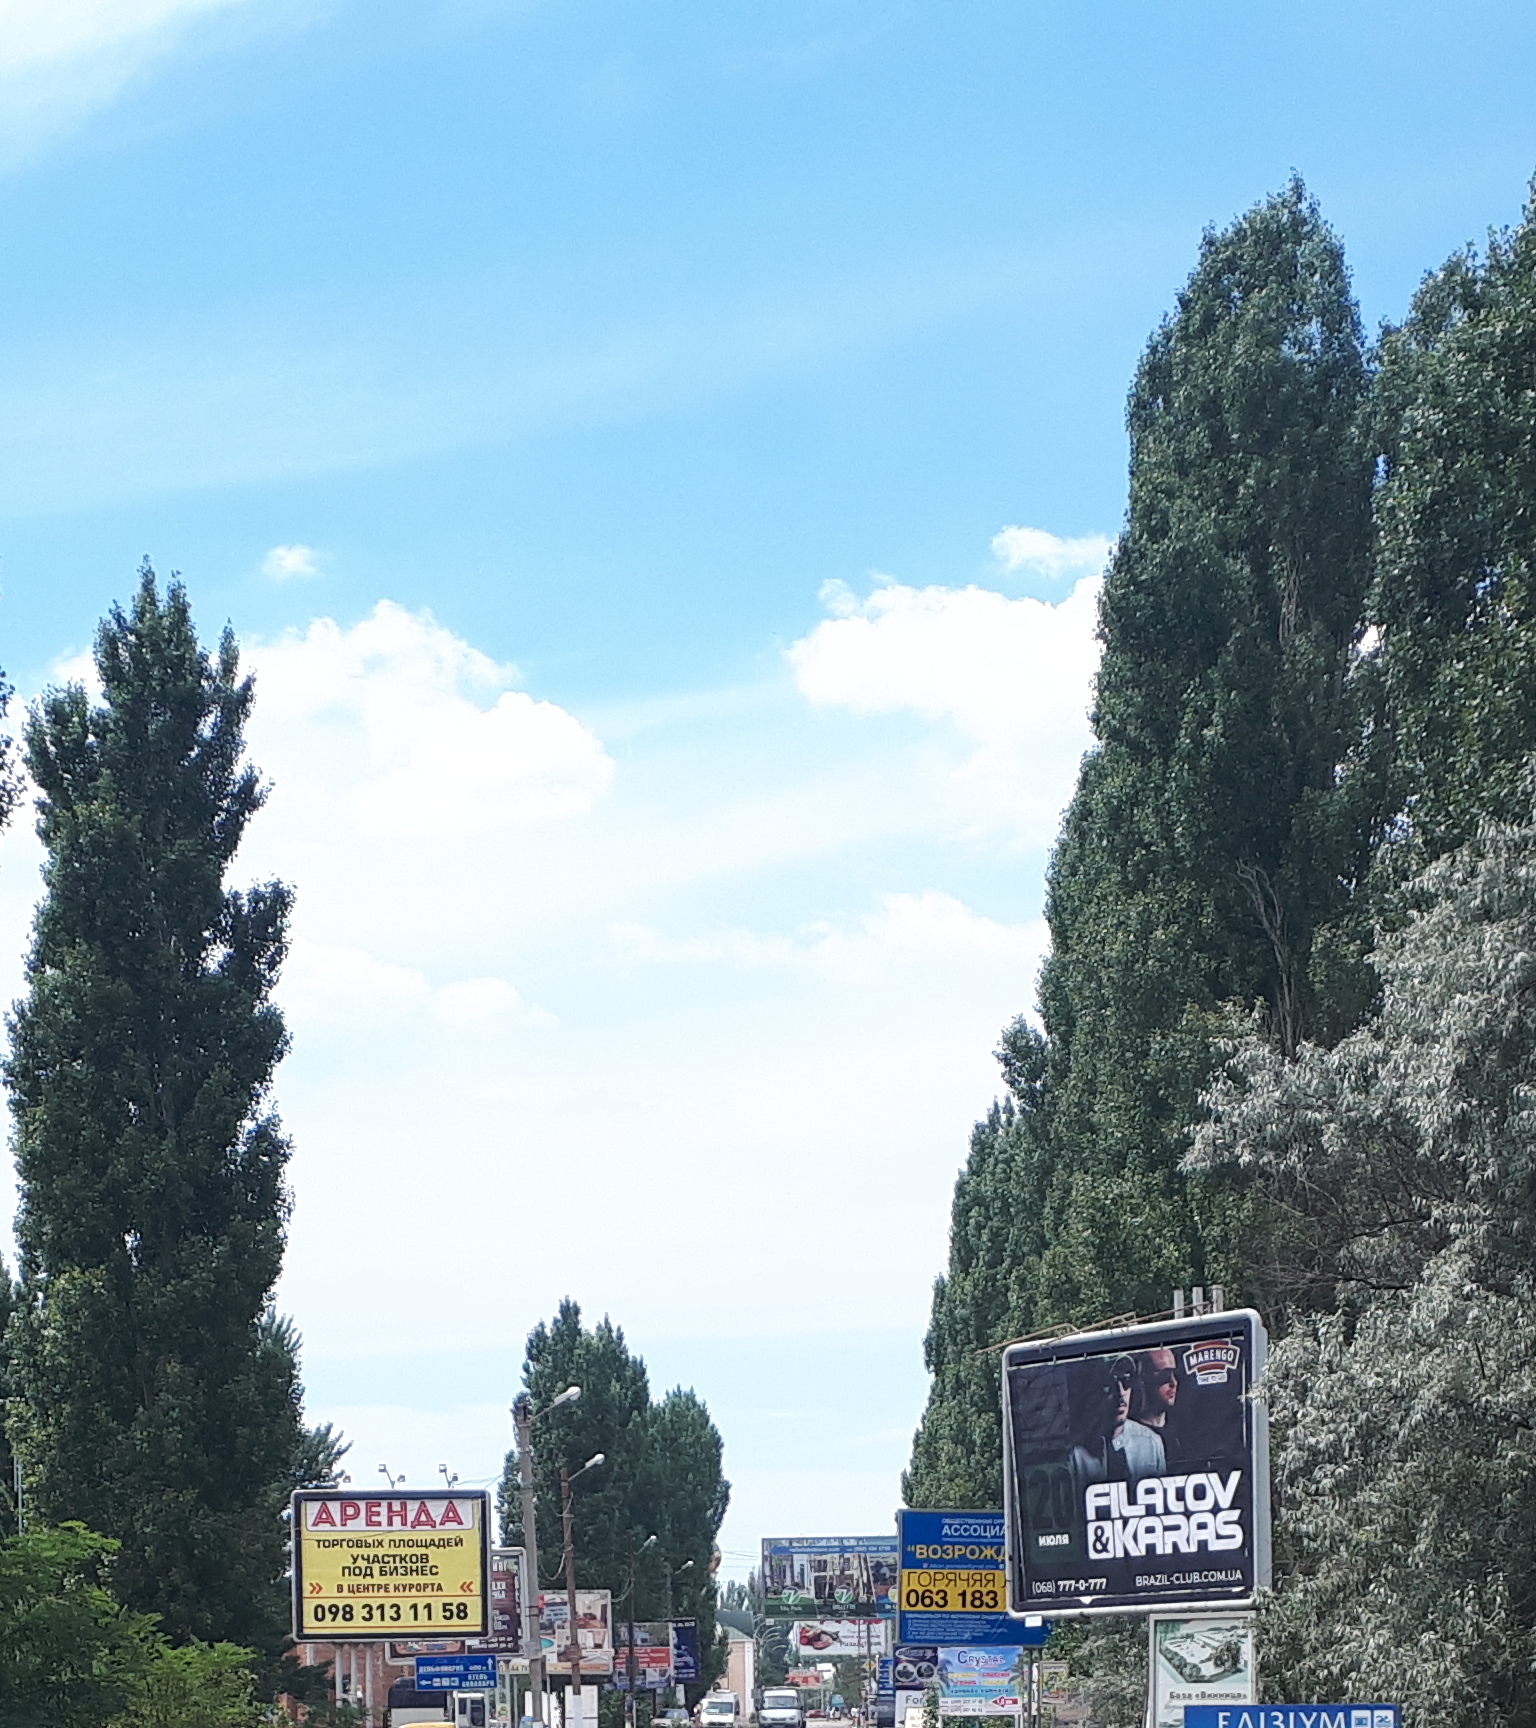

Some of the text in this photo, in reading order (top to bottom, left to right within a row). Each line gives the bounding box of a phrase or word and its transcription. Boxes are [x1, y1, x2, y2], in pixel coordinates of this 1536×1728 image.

[1189, 1348, 1235, 1367] MARENGO
[1085, 1470, 1242, 1520] FILATOV
[311, 1500, 464, 1529] АРЕНДА
[316, 1535, 464, 1550] ТОРГОВЫХ ПЛОЩАДЕЙ
[1038, 1533, 1070, 1547] ИЮЛЯ
[350, 1553, 430, 1565] УЧАСТКОВ
[341, 1564, 440, 1579] ПОД БИЗНЕС
[1135, 1569, 1243, 1587] BRAZIL-CLUB.COM.UA
[336, 1582, 444, 1595] В ЦЕНТРЕ КУРОРТА
[1032, 1577, 1107, 1595] (068) 777-0-777
[906, 1588, 999, 1609] 063 183
[314, 1602, 469, 1623] 098 313 11 58
